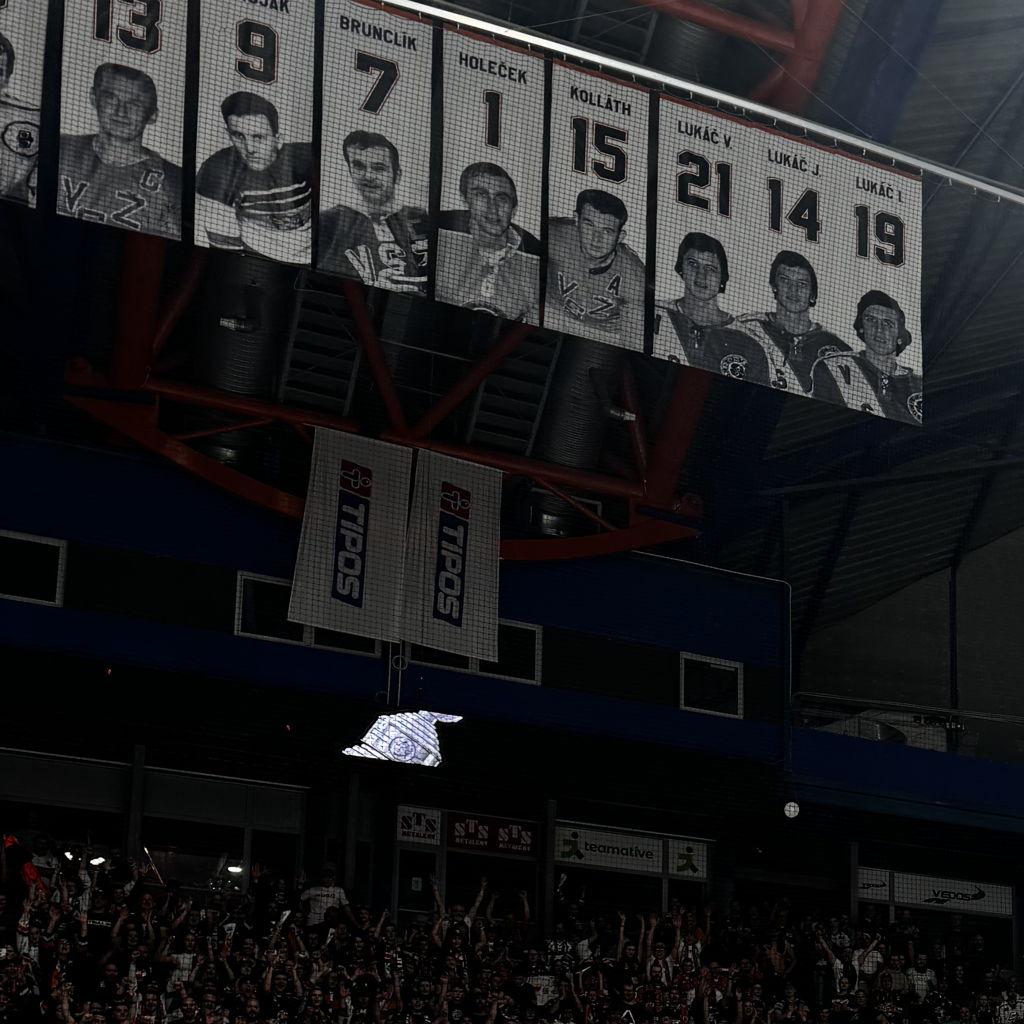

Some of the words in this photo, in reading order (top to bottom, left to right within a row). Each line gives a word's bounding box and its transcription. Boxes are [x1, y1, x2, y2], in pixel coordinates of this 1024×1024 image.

[92, 0, 163, 55] 13
[235, 18, 279, 85] 9
[354, 49, 400, 115] 7
[458, 52, 527, 85] HOLEČEK
[483, 89, 501, 150] 1
[570, 85, 632, 117] KOLLÁTH
[677, 119, 720, 146] LUKÁČ
[570, 116, 628, 184] 15
[767, 147, 808, 174] LUKÁČ
[675, 149, 733, 218] 21
[766, 177, 821, 244] 14
[855, 176, 894, 200] LUKÁČ
[854, 203, 906, 268] 19
[336, 503, 365, 600] TIPOS
[436, 525, 464, 620] TIPOS
[584, 841, 654, 859] teamative
